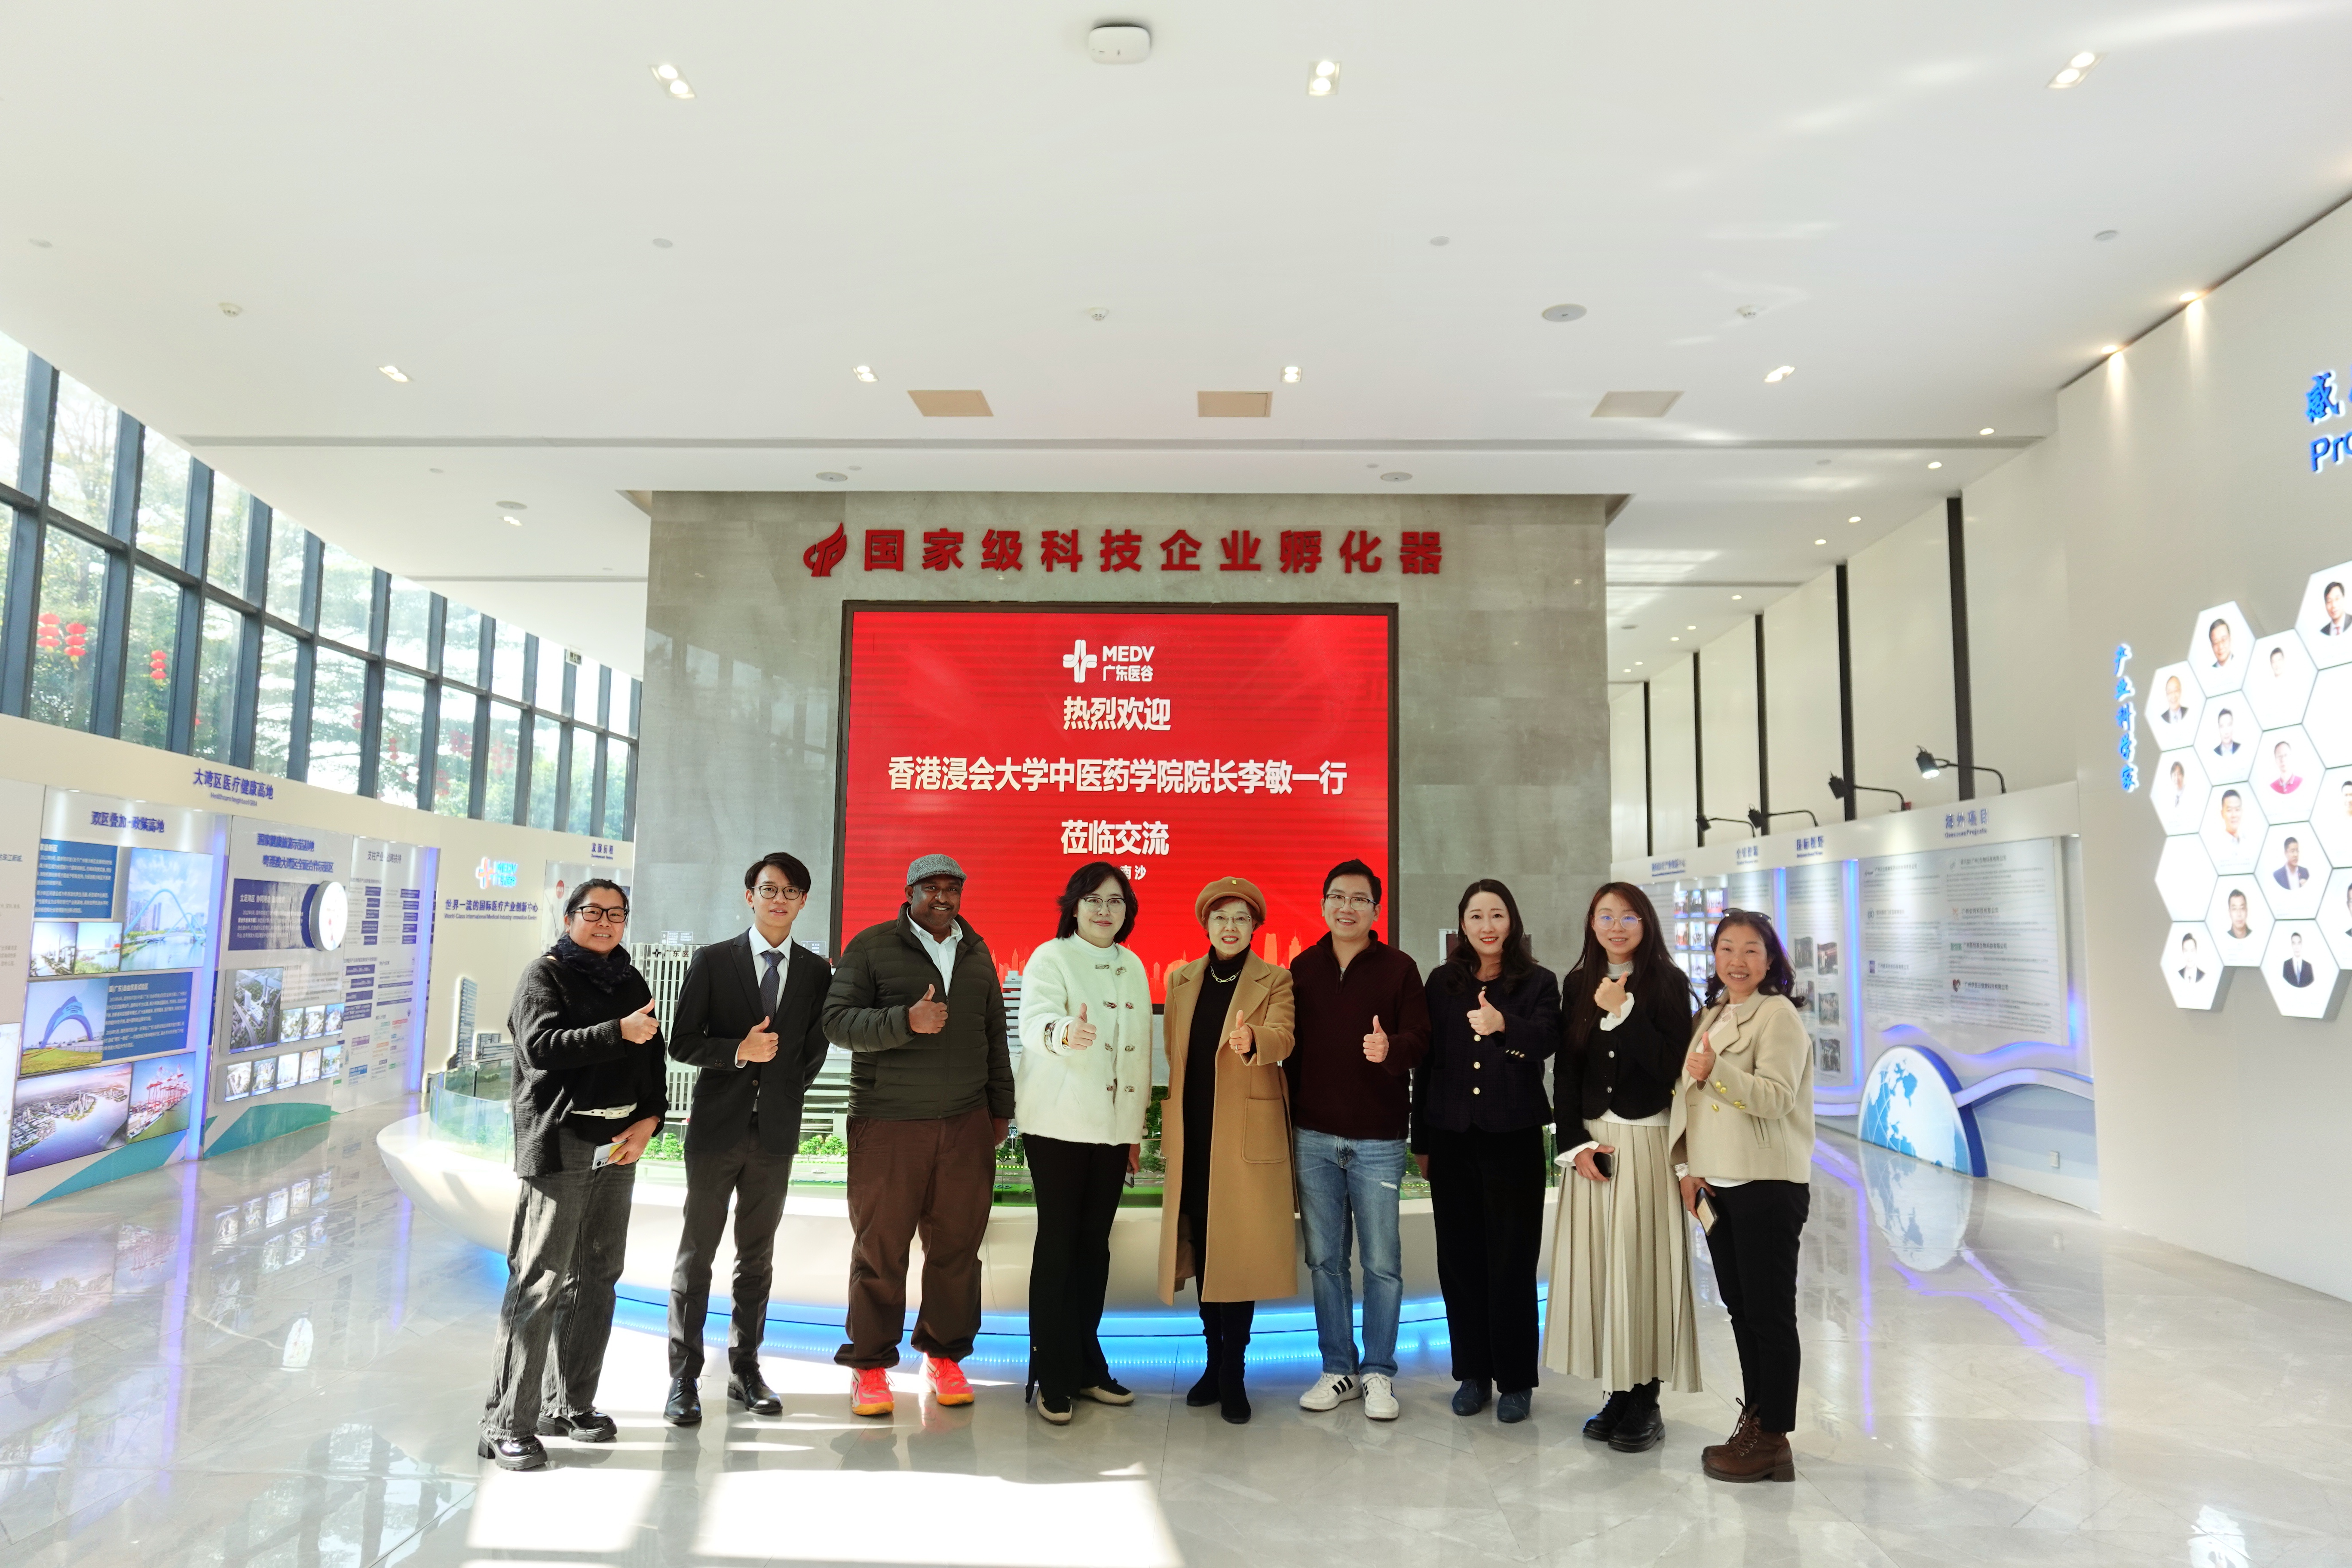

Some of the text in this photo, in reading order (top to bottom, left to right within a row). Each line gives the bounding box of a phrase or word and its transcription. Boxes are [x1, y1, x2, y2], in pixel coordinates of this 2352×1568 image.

[2305, 365, 2352, 423] 感
[864, 529, 1442, 575] 国家级科技企业孵化器
[1102, 646, 1155, 662] MEDV
[1103, 665, 1153, 682] 广东医谷
[1063, 696, 1172, 731] 热烈欢迎
[193, 768, 273, 799] 大湾区医疗健康高地
[888, 756, 1348, 796] 香港浸会大学中医药学院院长李敏一行
[1945, 808, 1988, 829] 海外项目
[1060, 819, 1170, 856] 莅临交流
[592, 843, 613, 854] 发展历程
[494, 861, 518, 874] MEDV
[445, 899, 538, 912] 世界一流的国际医疗产业创新中心
[664, 949, 694, 958] 广东医
